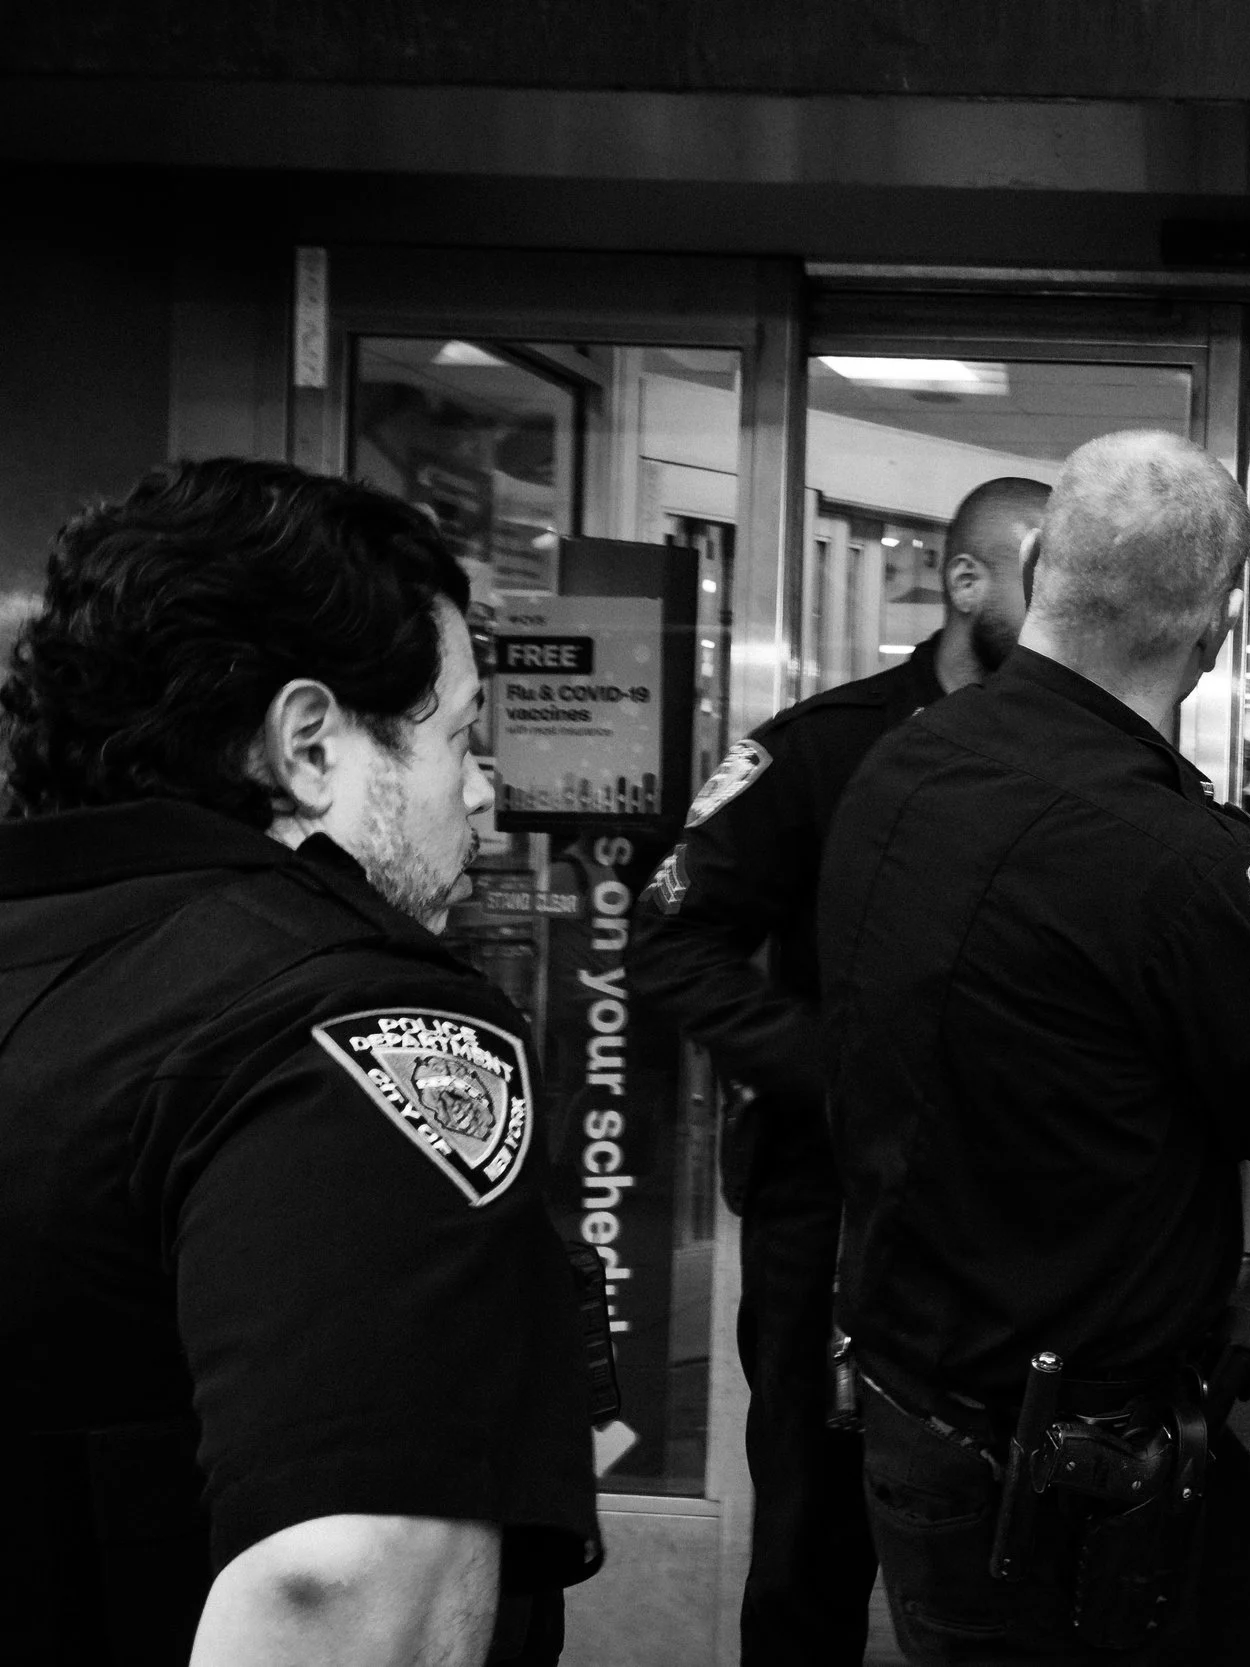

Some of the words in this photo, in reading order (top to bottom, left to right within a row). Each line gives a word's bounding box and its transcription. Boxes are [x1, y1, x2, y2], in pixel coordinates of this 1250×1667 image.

[507, 645, 578, 667] FREE
[539, 685, 554, 701] &
[558, 685, 651, 703] COVID-19
[506, 706, 592, 722] vaccines
[590, 880, 634, 951] on
[378, 1018, 479, 1042] POLICE
[578, 966, 630, 1096] your
[349, 1032, 514, 1083] DEPARTMENT
[367, 1068, 420, 1119] CITY
[417, 1123, 452, 1156] OF
